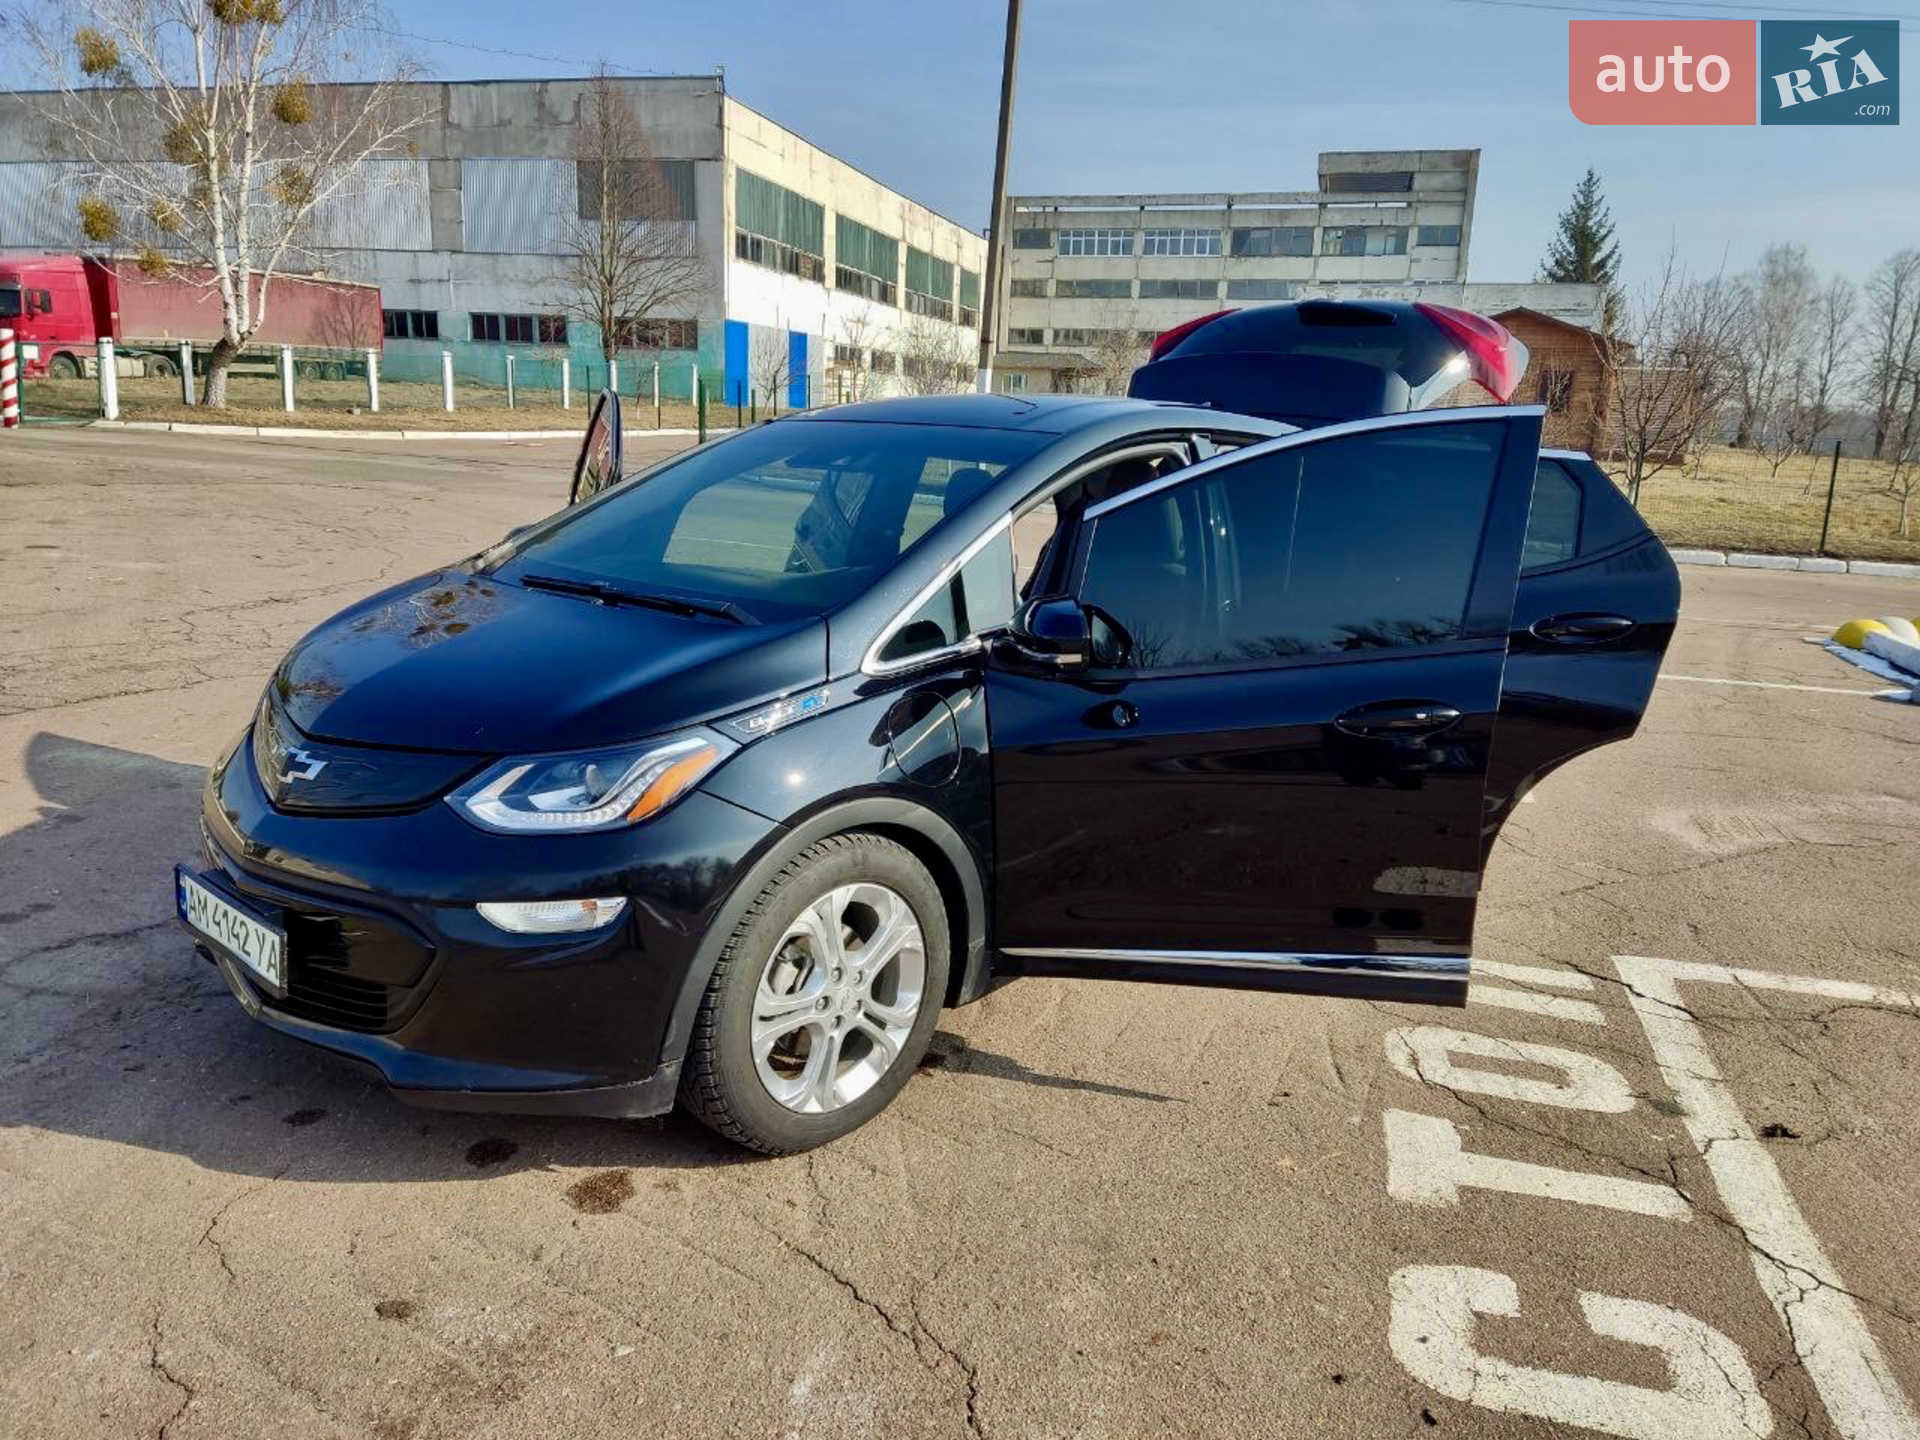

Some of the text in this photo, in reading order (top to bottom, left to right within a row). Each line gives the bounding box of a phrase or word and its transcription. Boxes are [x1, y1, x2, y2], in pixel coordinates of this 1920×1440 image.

[189, 885, 279, 979] AM 4142 YA
